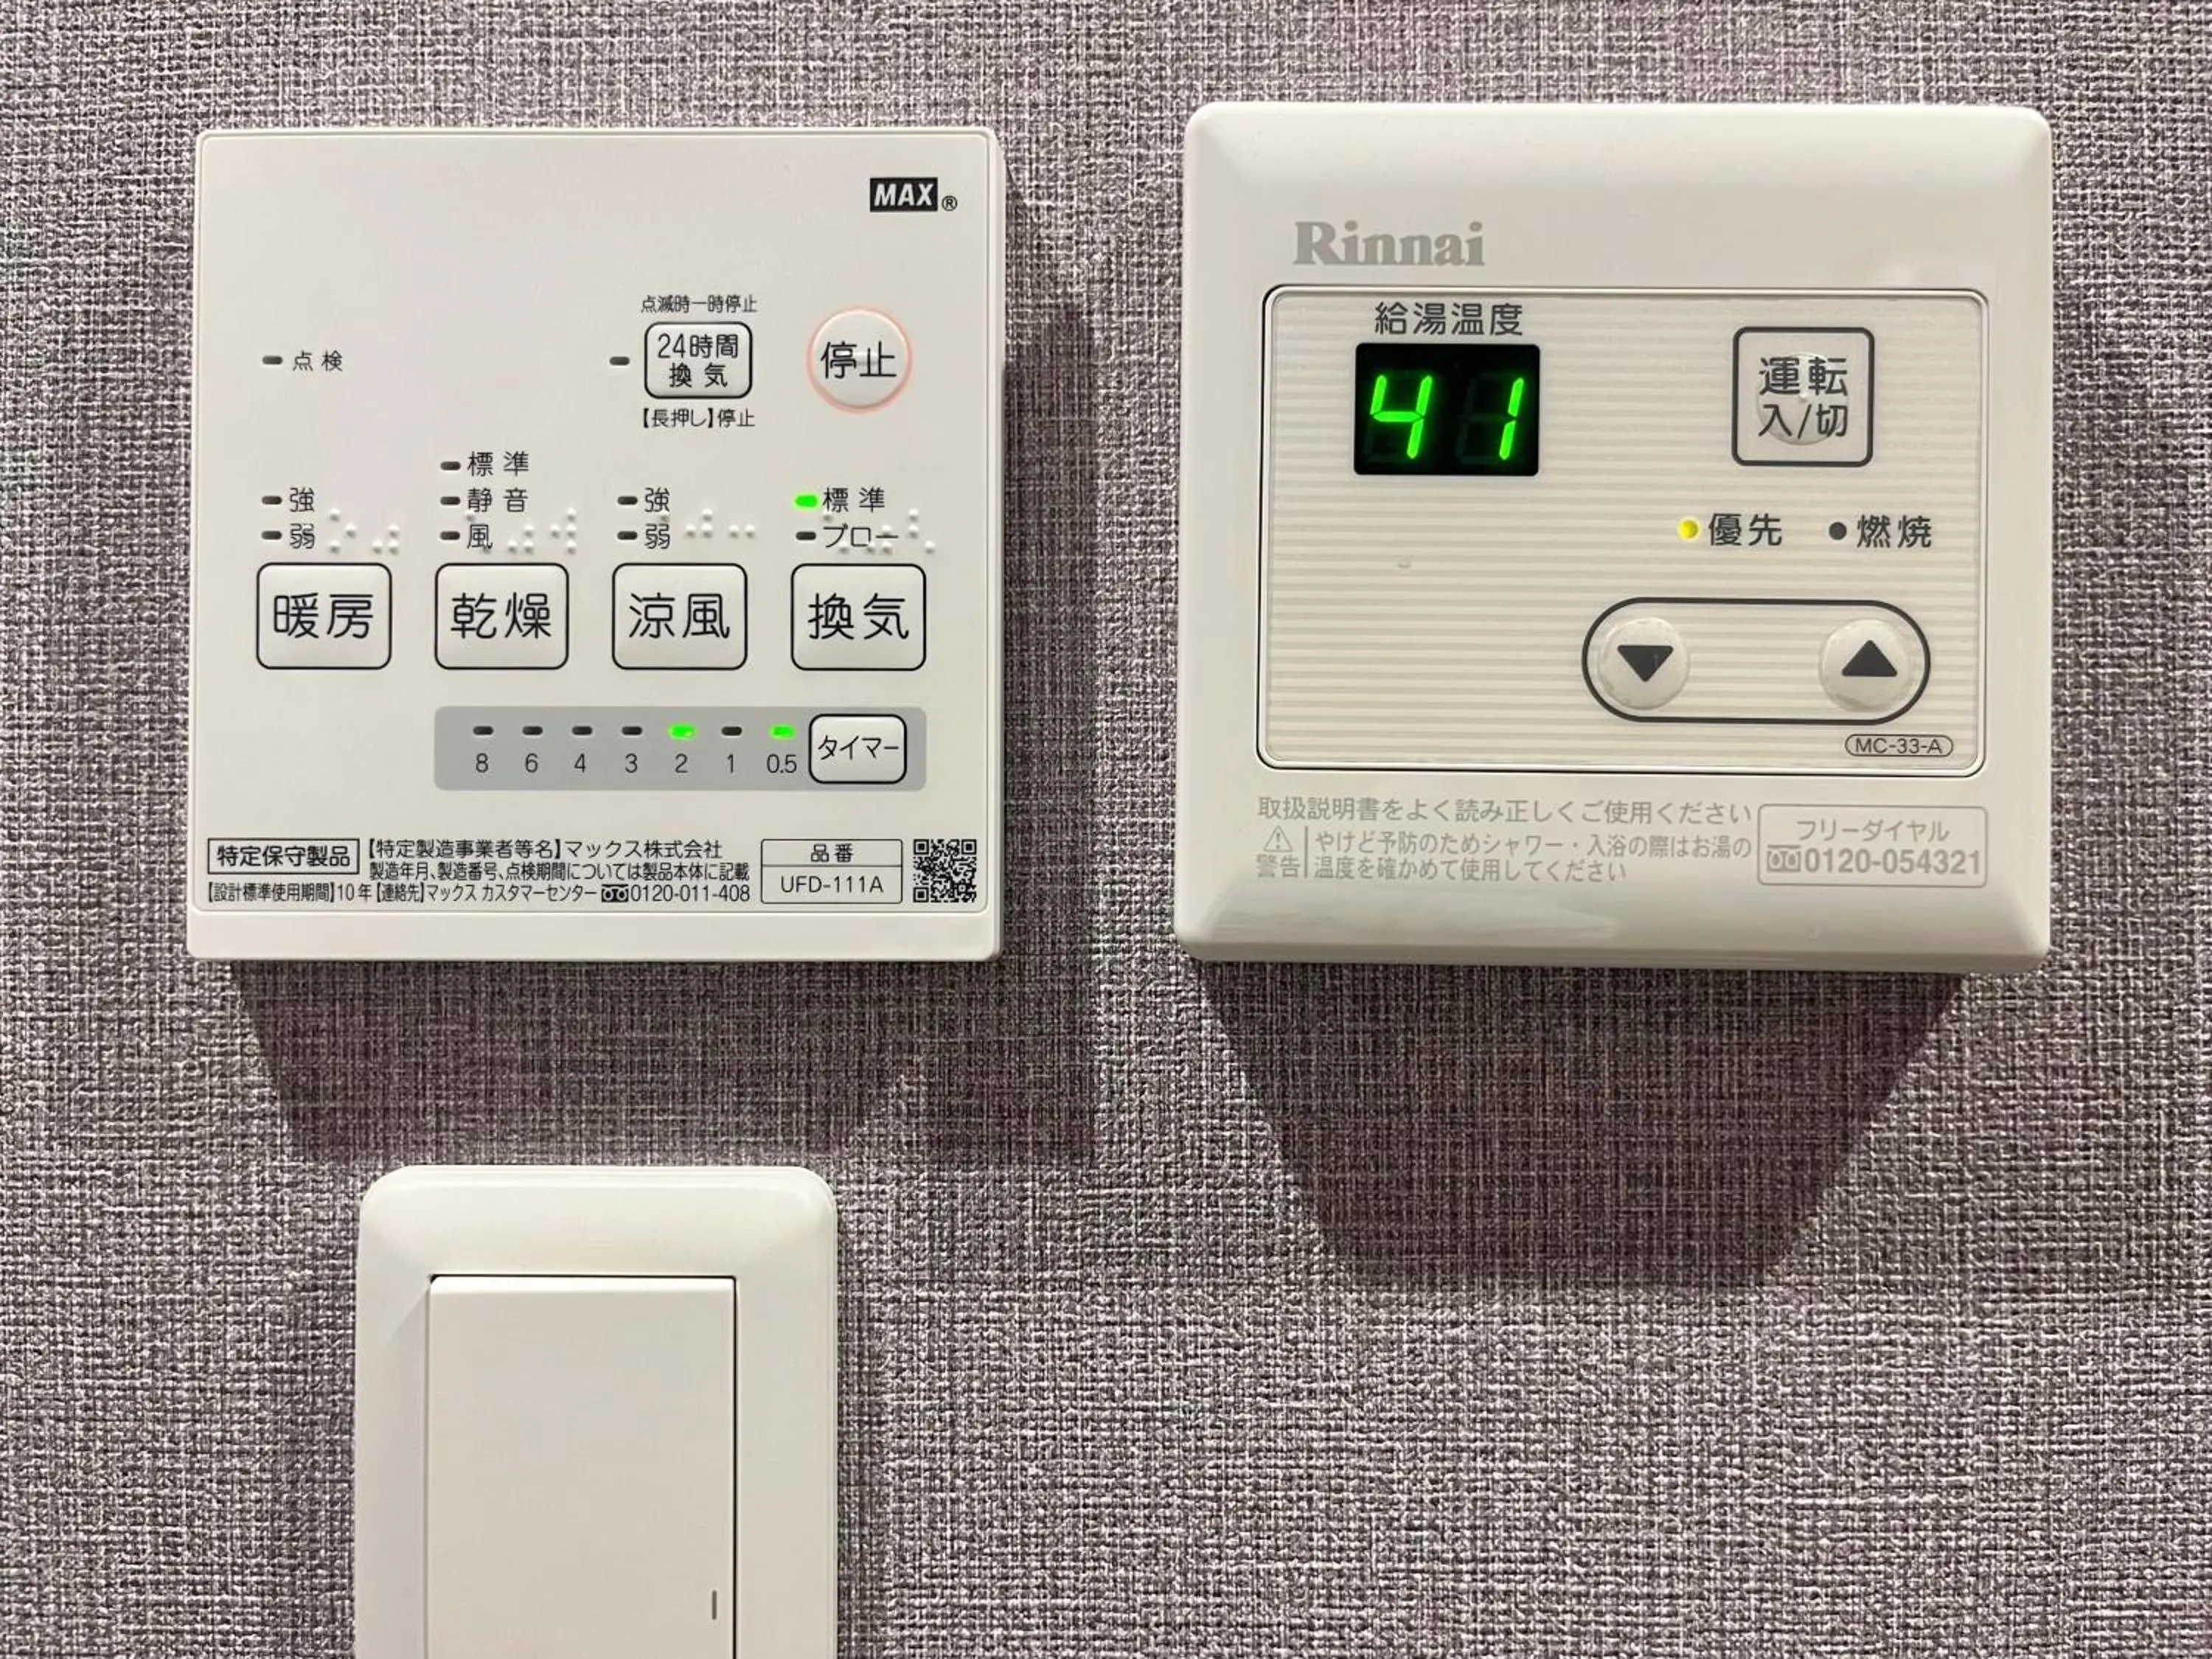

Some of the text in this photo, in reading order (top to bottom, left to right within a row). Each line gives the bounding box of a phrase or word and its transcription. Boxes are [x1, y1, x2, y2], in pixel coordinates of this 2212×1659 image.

[873, 183, 933, 206] MAX
[1293, 220, 1486, 267] Rinnai
[641, 294, 757, 313] 点滅時一時停止
[1374, 302, 1523, 336] 給湯温度
[657, 333, 739, 359] 24時間
[293, 349, 343, 372] 点検
[820, 341, 897, 379] 停止
[669, 362, 728, 389] 換気
[1759, 356, 1848, 397] 運転
[643, 407, 755, 429] 【長押し】停止
[1369, 375, 1525, 461] 41
[1758, 403, 1848, 440] 入/切
[467, 451, 529, 477] 標準
[289, 487, 315, 512] 強
[467, 487, 529, 512] 静音
[644, 487, 670, 513] 強
[822, 487, 886, 513] 標準
[290, 523, 316, 549] 弱
[467, 524, 493, 550] 風
[644, 523, 670, 550] 弱
[823, 524, 899, 549] ブロー
[1708, 513, 1782, 547] 優先
[1857, 514, 1932, 549] 燃焼
[274, 592, 374, 639] 暖房
[451, 591, 552, 639] 乾燥
[629, 592, 731, 639] 涼風
[807, 592, 909, 640] 換気
[817, 734, 899, 760] タイマー
[1854, 738, 1943, 754] MC-33-A
[476, 753, 797, 773] 8 6 4 3 2 1 0.5
[1797, 818, 1950, 843] フリーダイヤル
[217, 845, 350, 867] 特定保守製品
[810, 843, 853, 863] 品番
[1256, 853, 1301, 879] 警告
[1804, 847, 1980, 875] 0120-054321
[630, 883, 751, 902] 0120-011-408
[781, 875, 884, 893] UFD-111A
